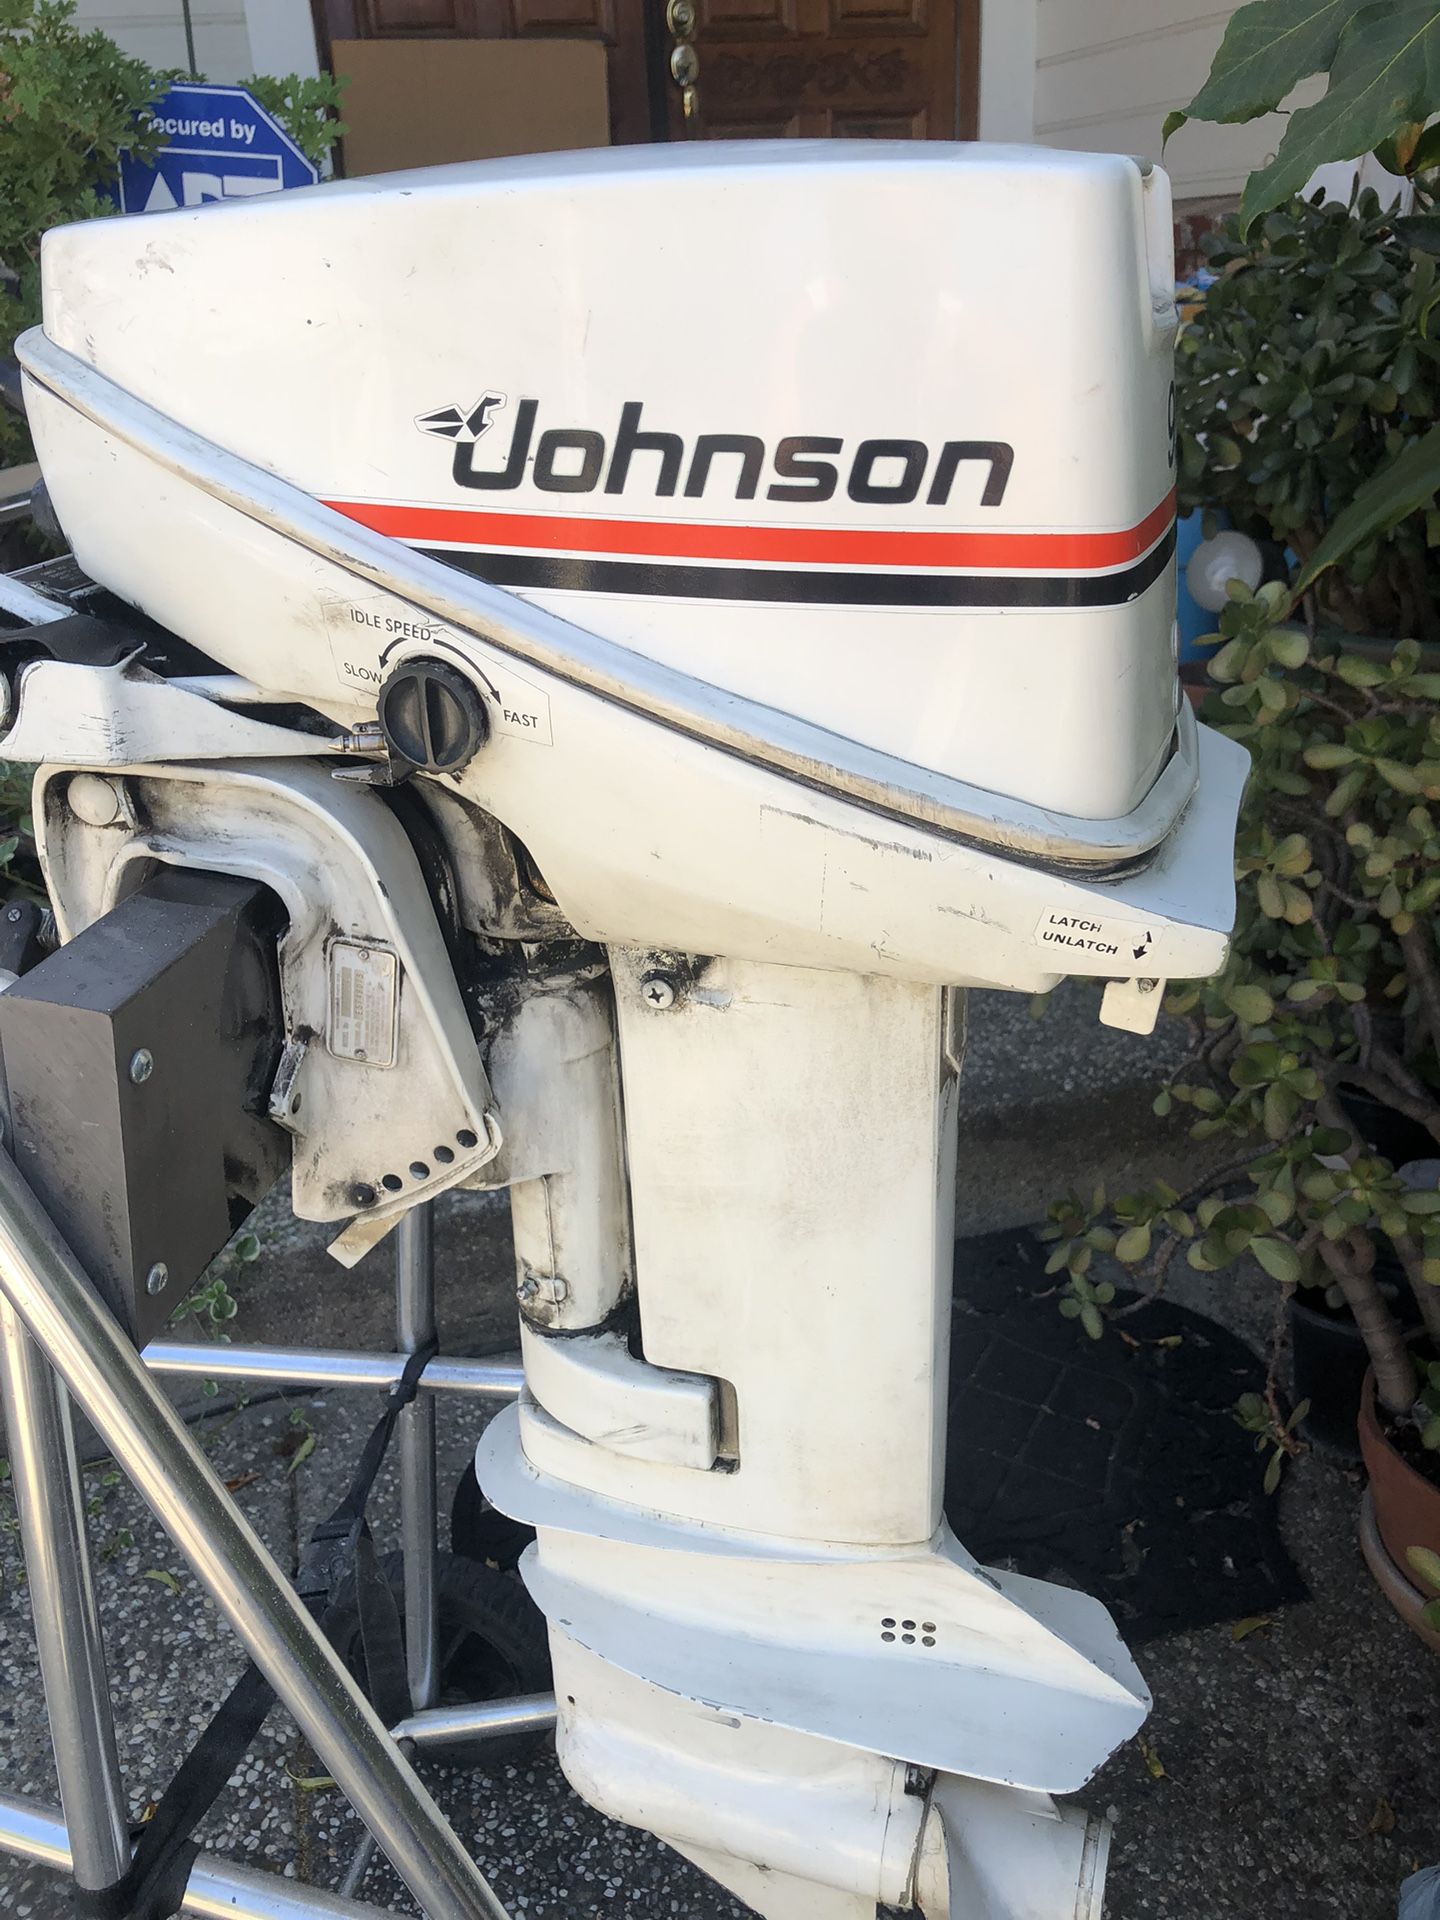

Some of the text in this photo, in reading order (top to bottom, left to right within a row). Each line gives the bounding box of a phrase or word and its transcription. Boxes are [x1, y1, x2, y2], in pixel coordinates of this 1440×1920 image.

[230, 118, 256, 144] by
[452, 398, 1014, 506] Johnson
[350, 608, 431, 642] IDLE SPEED
[343, 662, 383, 684] SLOW
[503, 708, 539, 729] FAST
[1049, 914, 1103, 933] LATCH
[1042, 931, 1119, 955] UNLATCH
